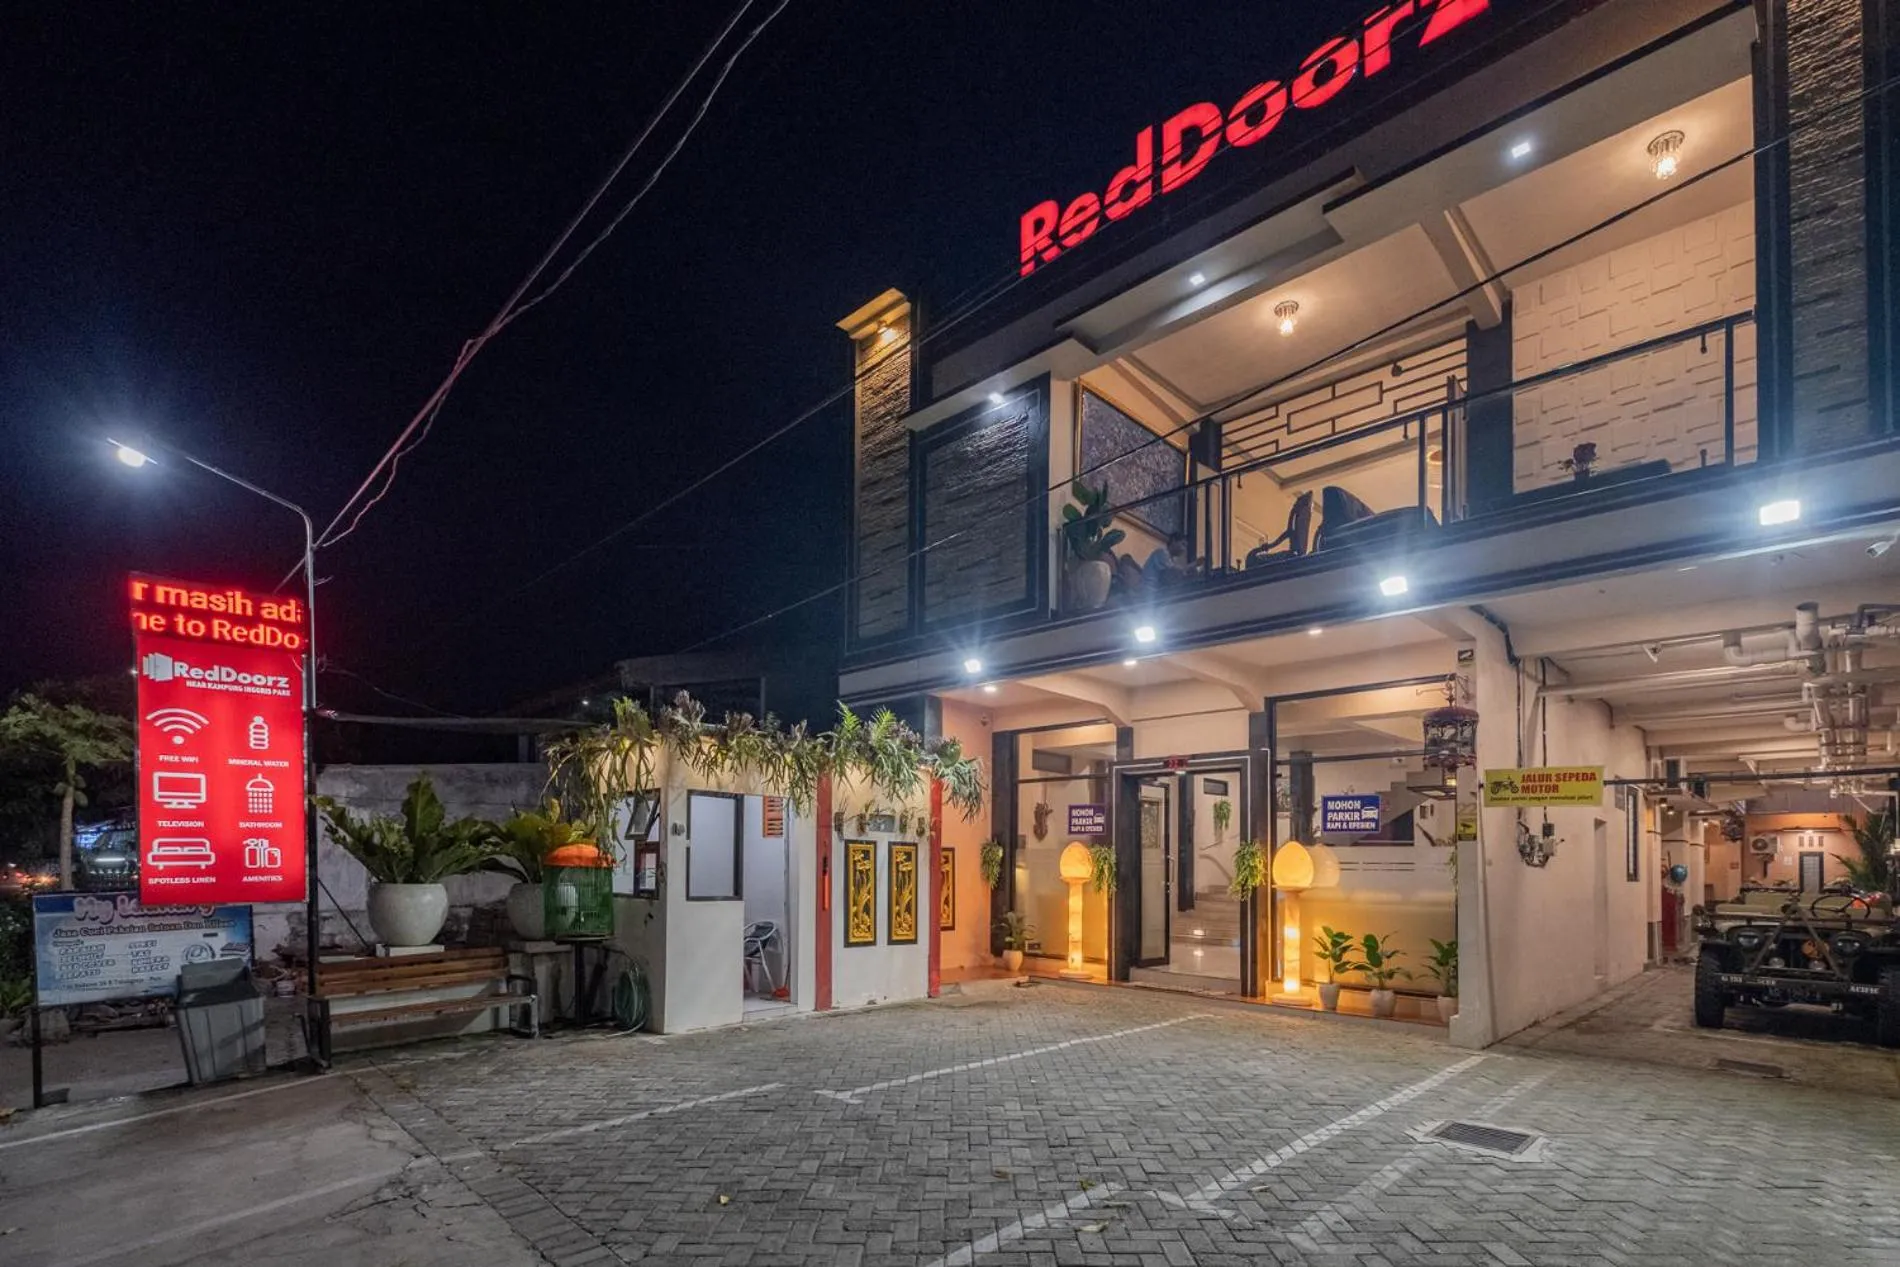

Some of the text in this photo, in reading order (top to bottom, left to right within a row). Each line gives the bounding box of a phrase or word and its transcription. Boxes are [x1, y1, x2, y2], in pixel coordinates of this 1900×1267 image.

[155, 585, 253, 616] masih
[174, 613, 206, 637] to
[211, 619, 300, 649] RedDo
[174, 661, 290, 688] RedDoorz
[185, 679, 207, 689] NEAR
[207, 681, 243, 693] KAMPUNG
[158, 754, 199, 764] FREE WIFI
[228, 758, 290, 768] MINERAL WATER
[1520, 772, 1597, 783] JALUR SEPEDA
[1520, 784, 1559, 794] MOTOR
[1327, 800, 1361, 810] MOHON
[1071, 808, 1094, 817] MOHON
[1327, 811, 1361, 821] PARKIR
[156, 820, 205, 828] TELEVISION
[238, 821, 283, 829] BATHROOM
[1071, 817, 1093, 825] PARKIR
[1327, 821, 1341, 829] RAPI
[148, 876, 216, 885] SPOTLESS LINEN
